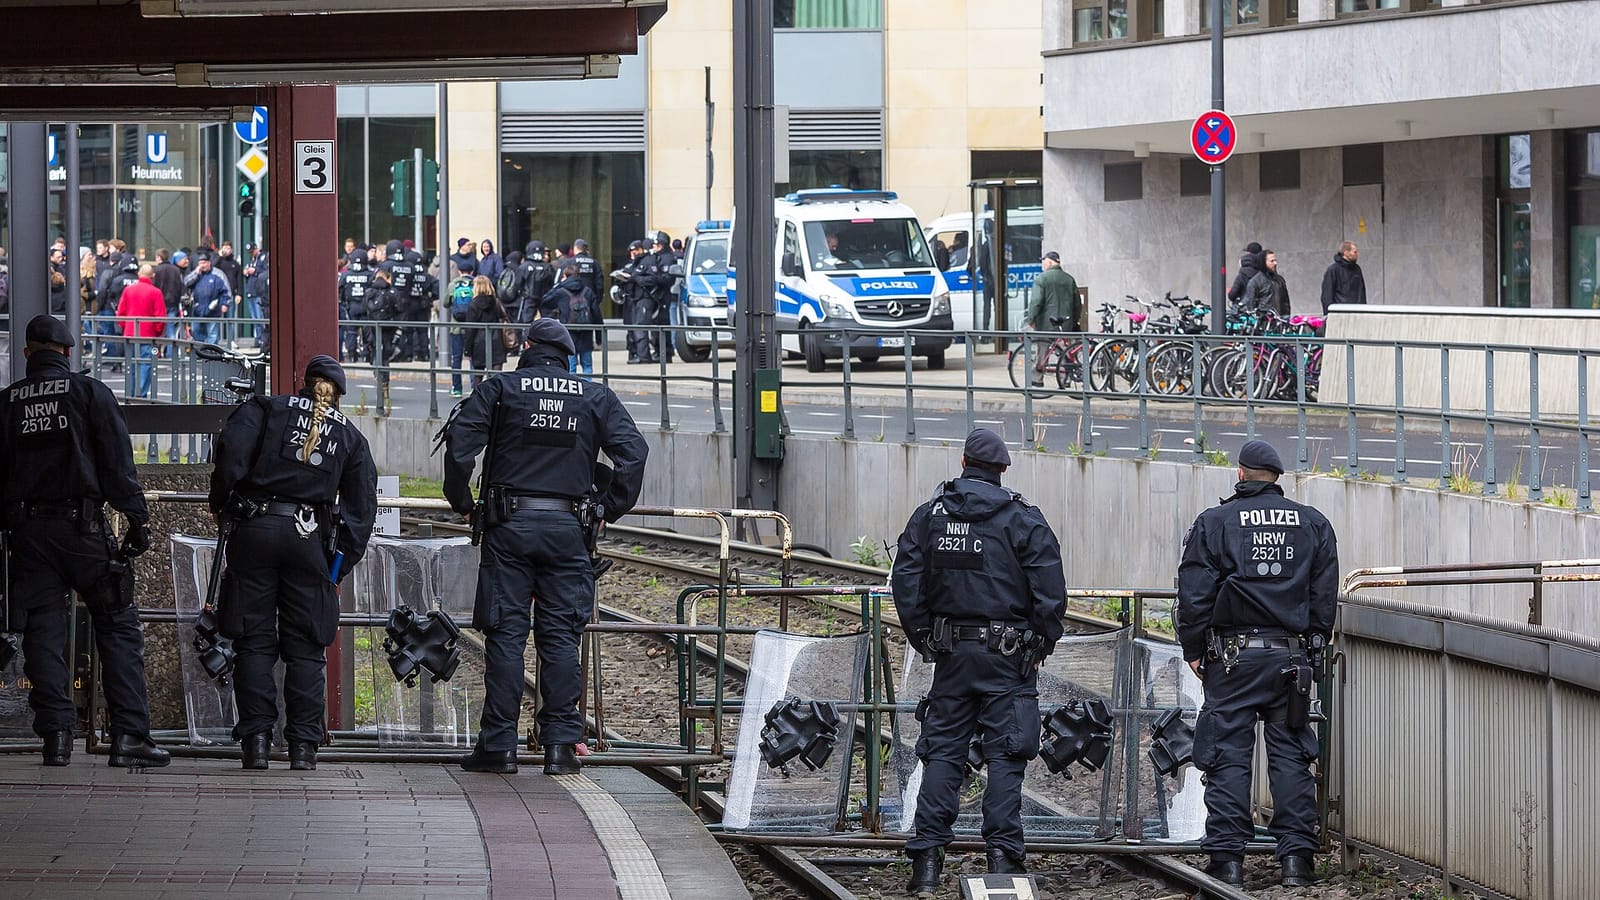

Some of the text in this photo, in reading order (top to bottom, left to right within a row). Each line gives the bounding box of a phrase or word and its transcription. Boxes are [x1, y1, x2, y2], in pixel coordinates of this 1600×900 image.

[303, 145, 326, 153] Gleis
[131, 165, 182, 179] Heumarkt
[303, 157, 327, 189] 3
[860, 281, 918, 291] POLIZEI
[10, 379, 70, 402] POLIZEI
[521, 377, 583, 395] POLIZEI
[24, 401, 59, 419] NRW
[539, 399, 564, 412] NRW
[21, 415, 68, 434] 2512 D
[530, 413, 578, 431] 2512 H
[290, 430, 338, 455] 252 M
[1239, 509, 1301, 526] POLIZEI
[946, 522, 970, 535] NRW
[937, 537, 982, 552] 2521 C
[1253, 532, 1286, 545] NRW
[1251, 546, 1294, 560] 2521 B
